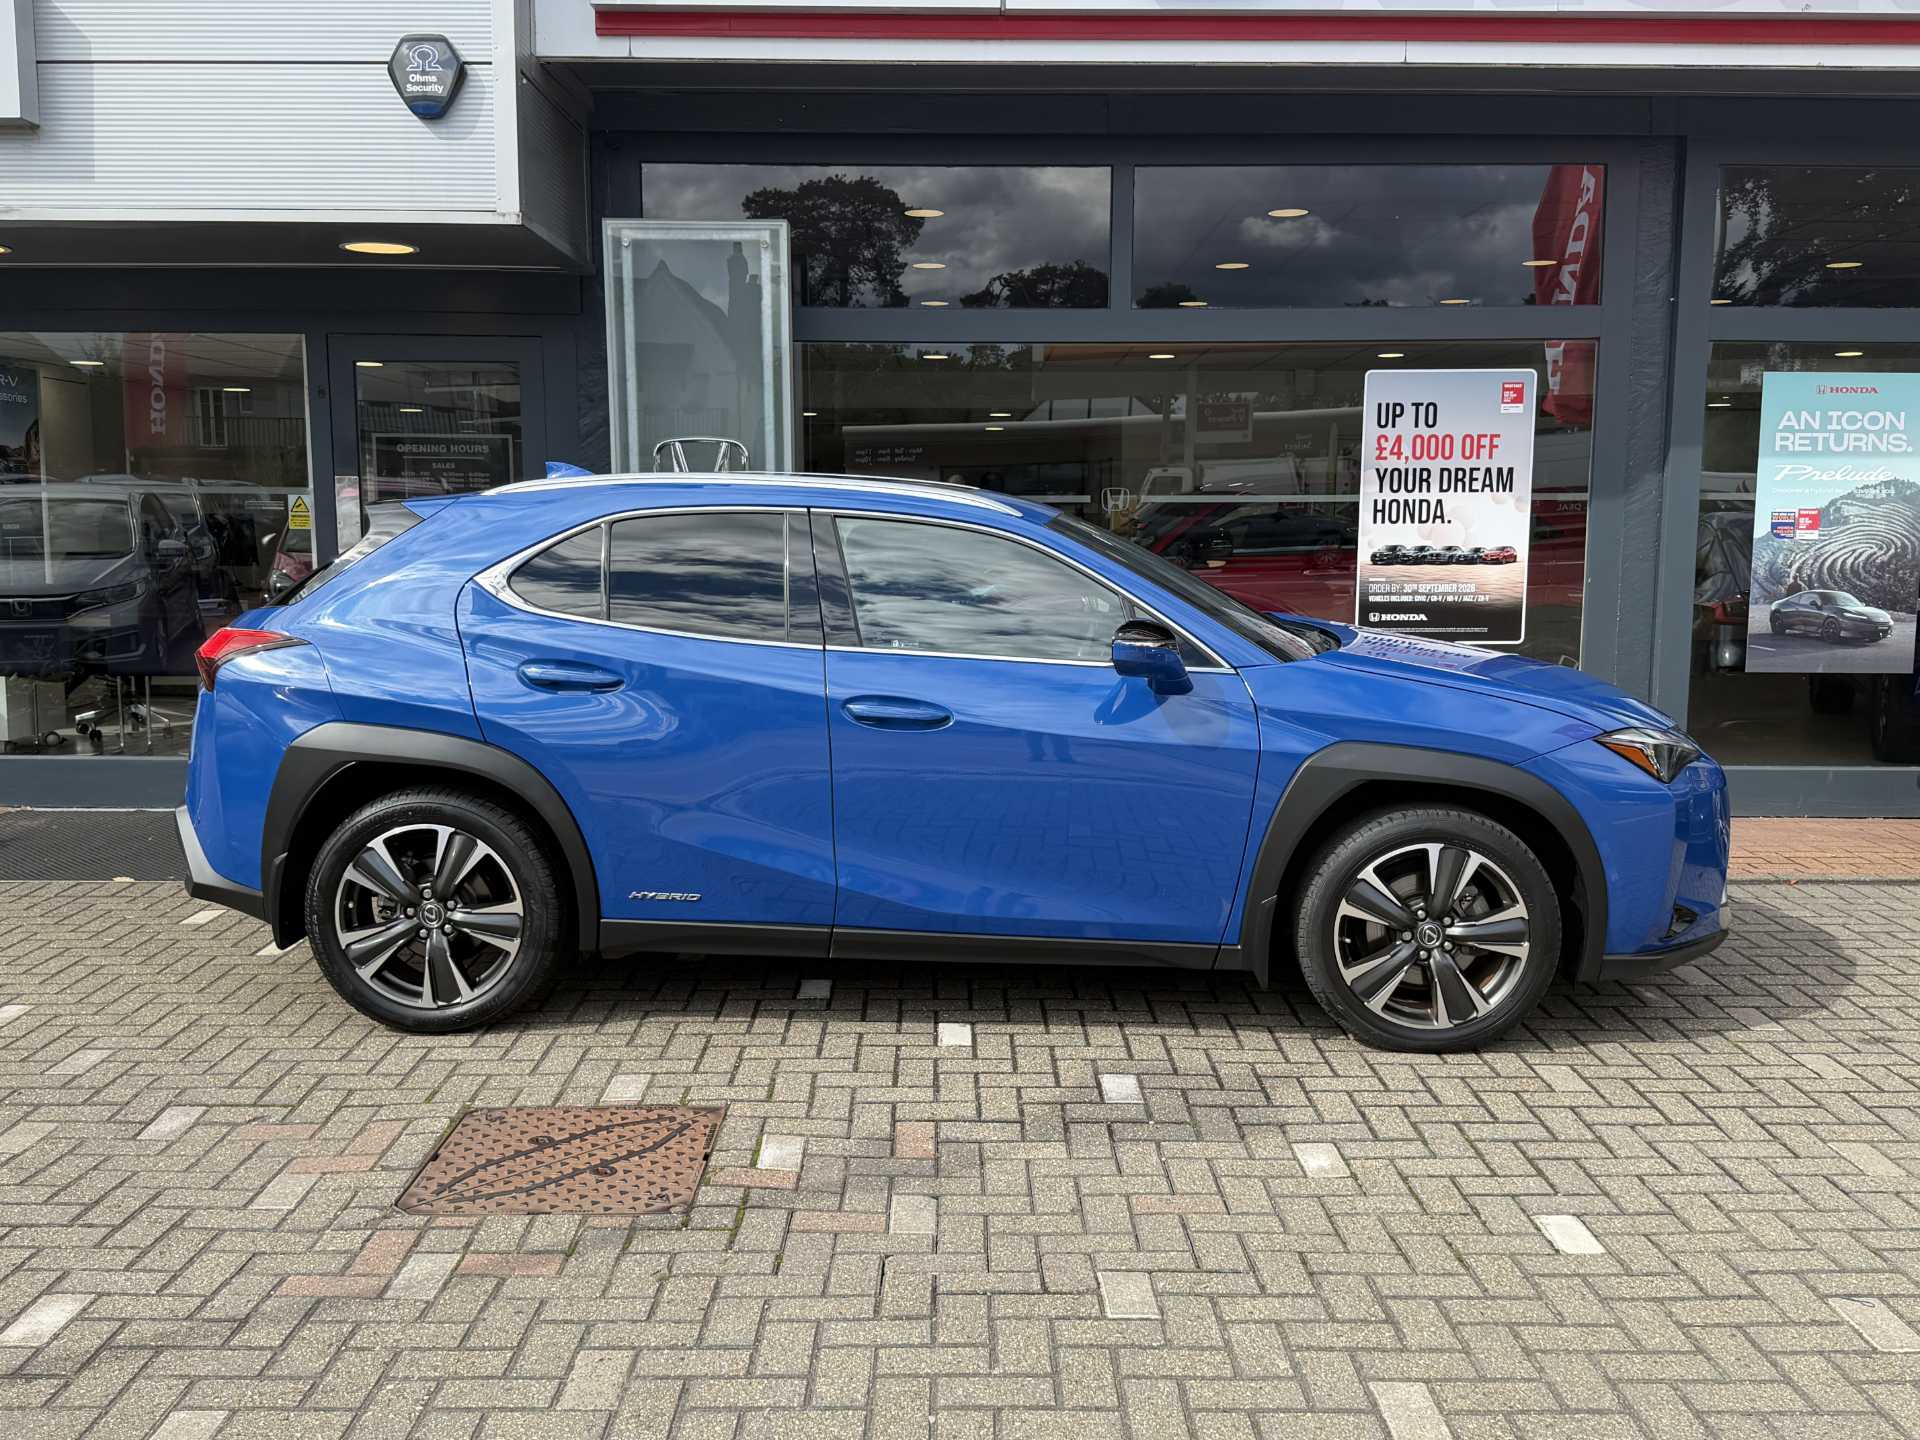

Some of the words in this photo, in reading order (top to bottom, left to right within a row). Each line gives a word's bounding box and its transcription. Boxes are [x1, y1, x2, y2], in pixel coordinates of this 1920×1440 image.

[409, 73, 437, 83] Ohms
[406, 84, 444, 94] Security
[1376, 402, 1404, 429] UP
[1411, 402, 1438, 429] TO
[1778, 411, 1820, 430] AN
[1827, 411, 1905, 431] ICON
[396, 444, 448, 453] OPENING
[450, 444, 489, 453] HOURS
[1375, 433, 1454, 464] £4,000
[1461, 433, 1501, 460] OFF
[1775, 432, 1913, 453] RETURNS.
[1376, 467, 1431, 493] YOUR
[1439, 467, 1514, 493] DREAM
[1773, 464, 1894, 481] Prelude
[1372, 499, 1452, 525] HONDA.
[1369, 584, 1390, 592] ORDER
[1392, 584, 1402, 592] BY:
[1418, 584, 1457, 592] SEPTEMBER
[629, 891, 701, 901] HYBRID
